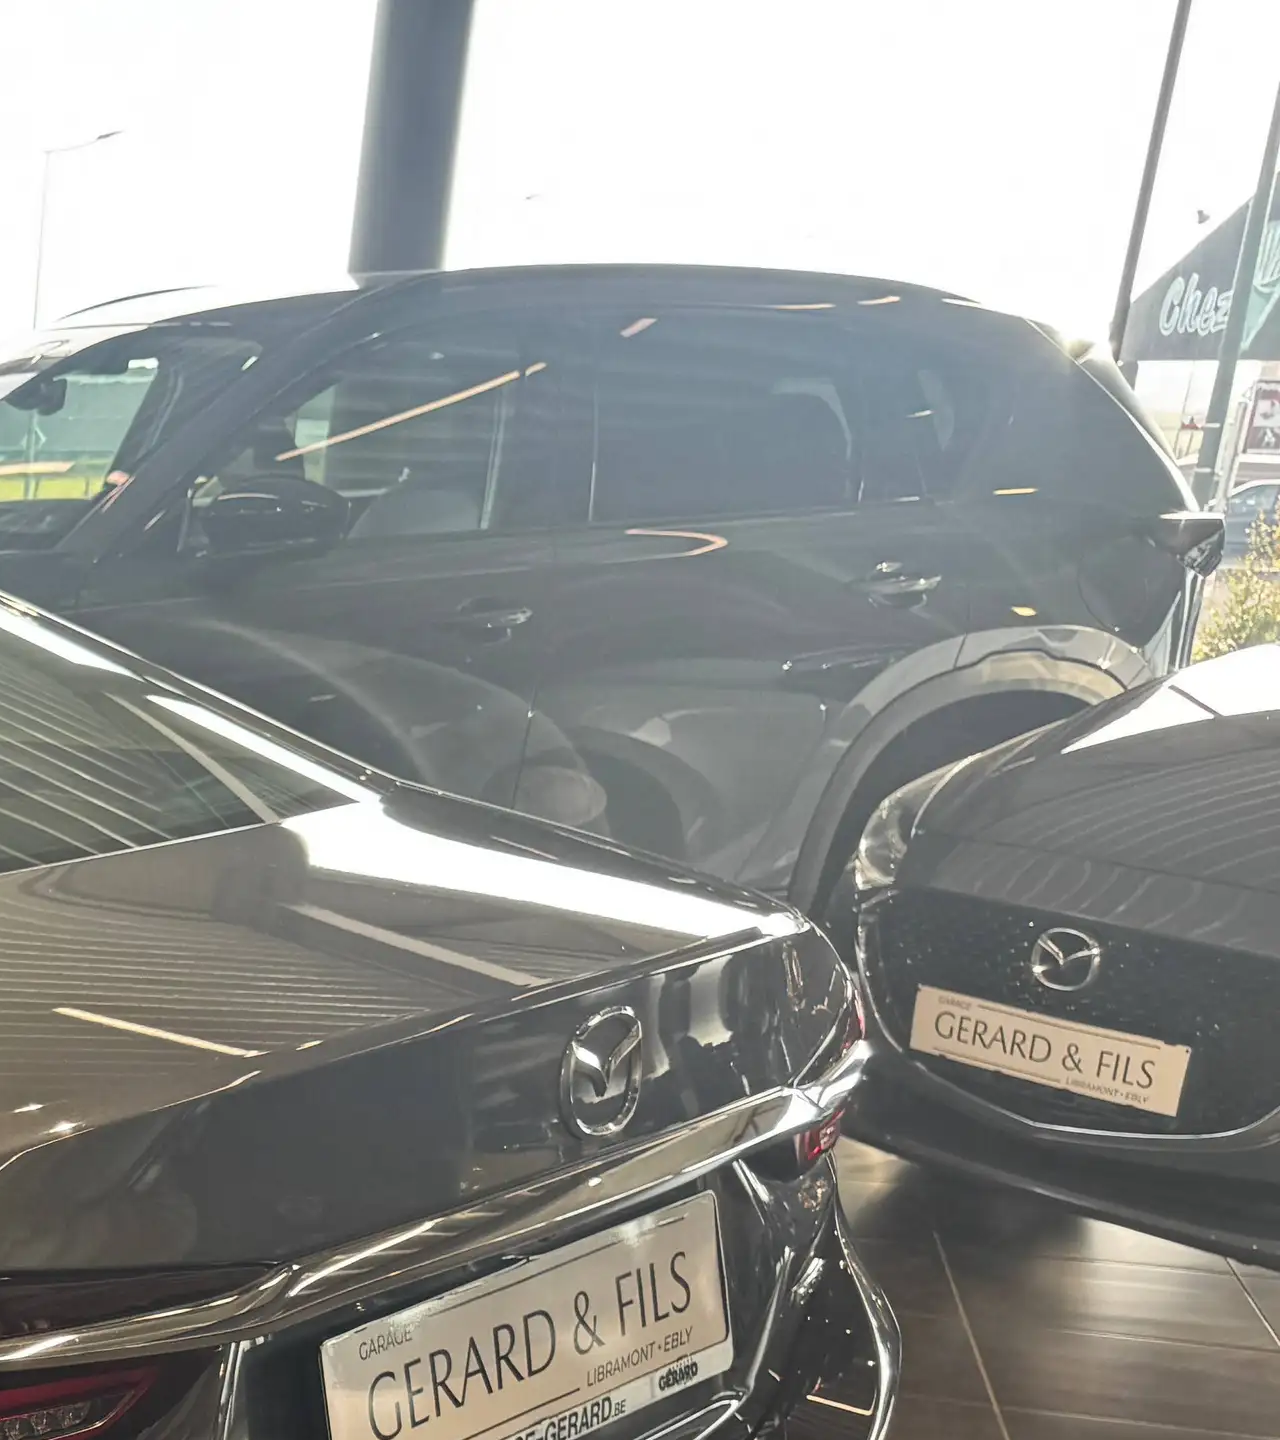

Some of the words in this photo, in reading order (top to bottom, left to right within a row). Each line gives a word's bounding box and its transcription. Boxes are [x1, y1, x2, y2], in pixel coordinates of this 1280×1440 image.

[934, 1010, 1052, 1063] GERARD
[1061, 1042, 1084, 1074] &
[1095, 1049, 1156, 1090] FILS
[573, 1289, 606, 1356] &
[614, 1250, 692, 1337] FILS
[358, 1326, 414, 1361] GARAGE
[586, 1340, 656, 1388] LIBRAMONT
[664, 1325, 694, 1353] EBLY
